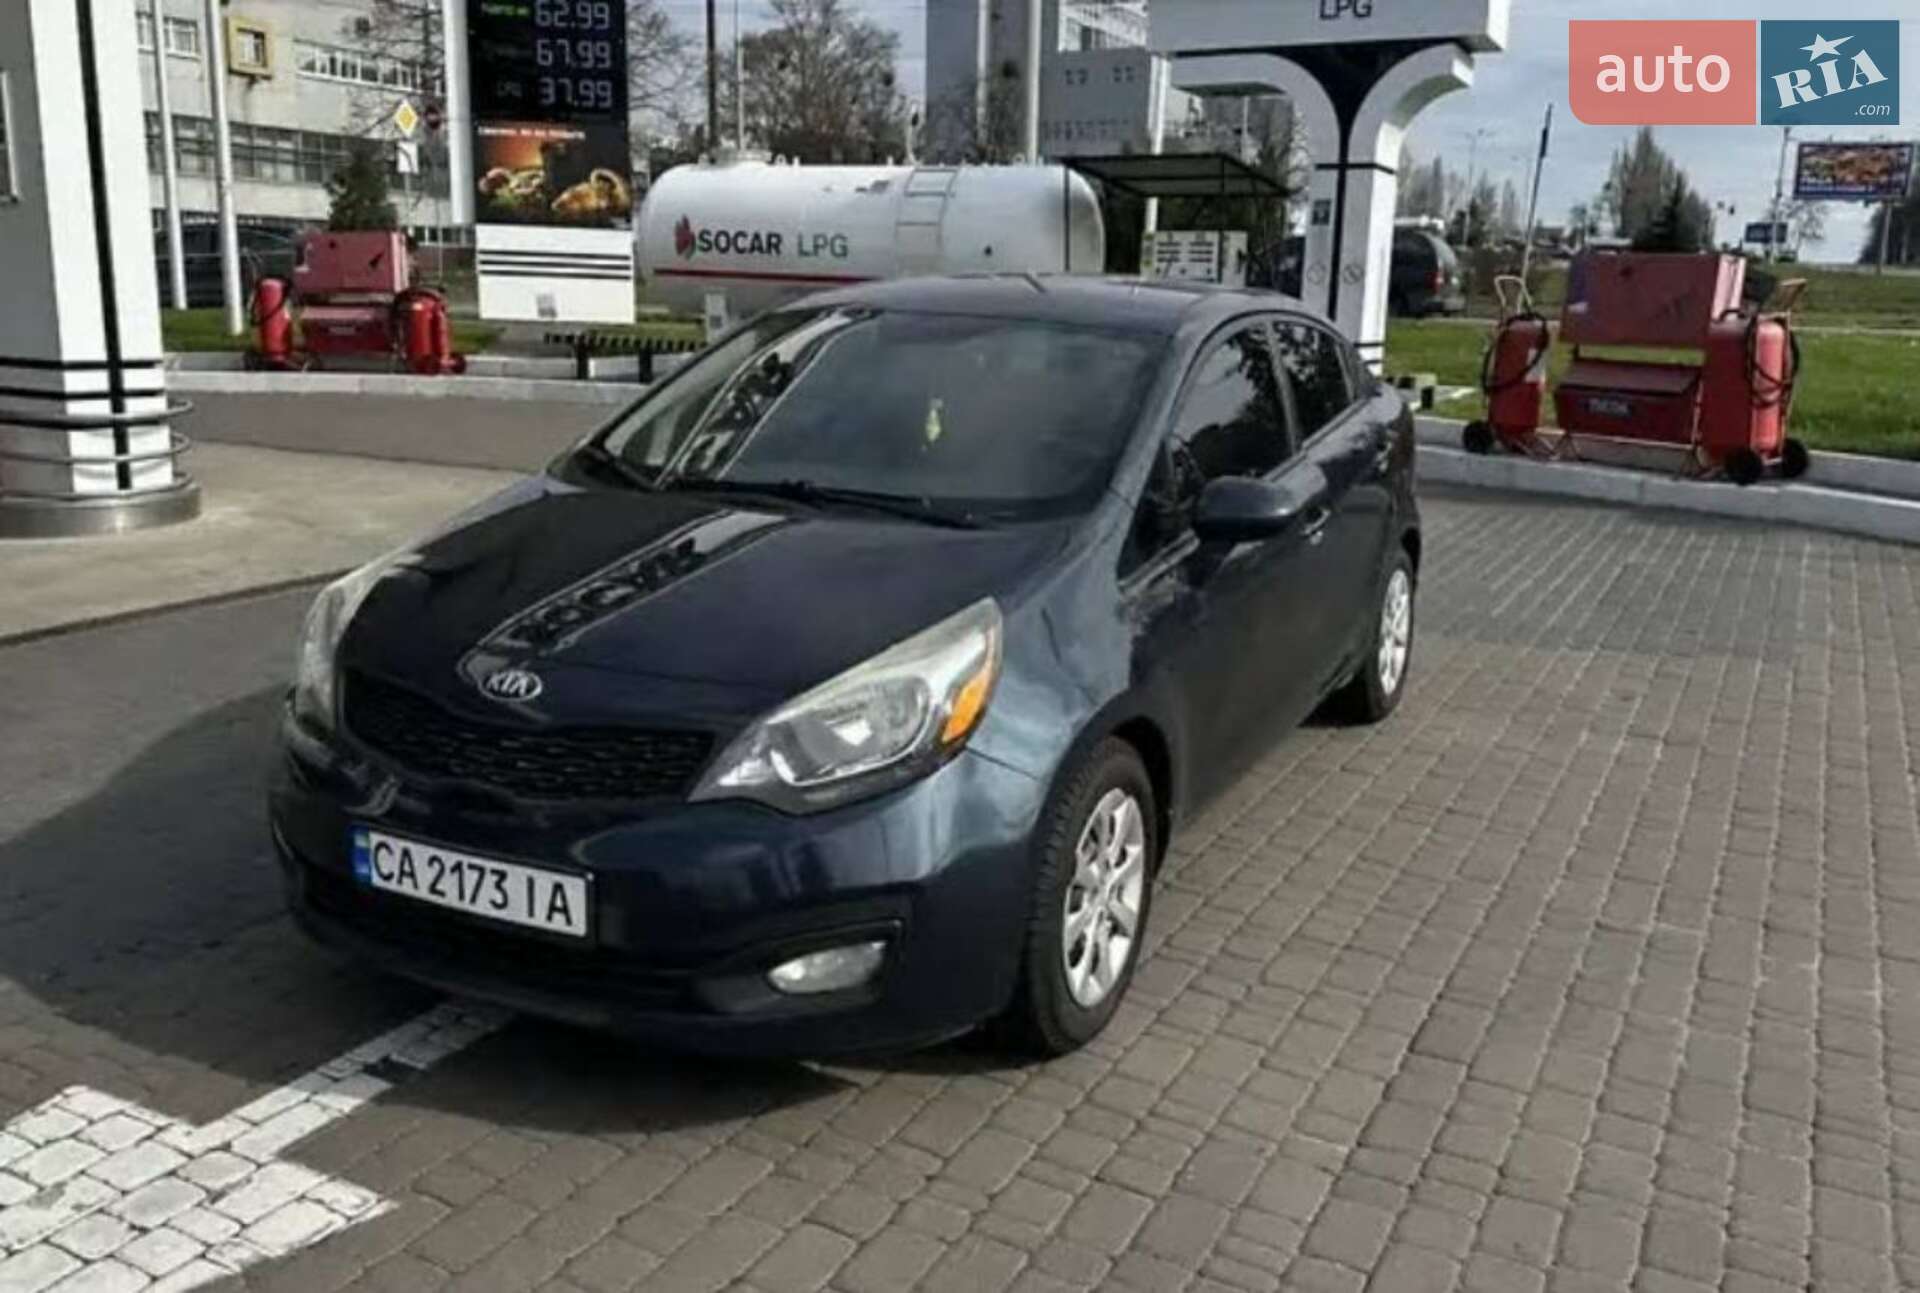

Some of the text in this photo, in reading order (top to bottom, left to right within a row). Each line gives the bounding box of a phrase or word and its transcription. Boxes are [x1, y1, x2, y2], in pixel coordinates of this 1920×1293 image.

[535, 0, 610, 29] 62.99
[536, 39, 612, 68] 67.99
[539, 78, 612, 107] 37.99
[698, 228, 849, 259] SOCAR LPG
[484, 671, 532, 697] KIA
[373, 841, 572, 926] CA 2173 IA
